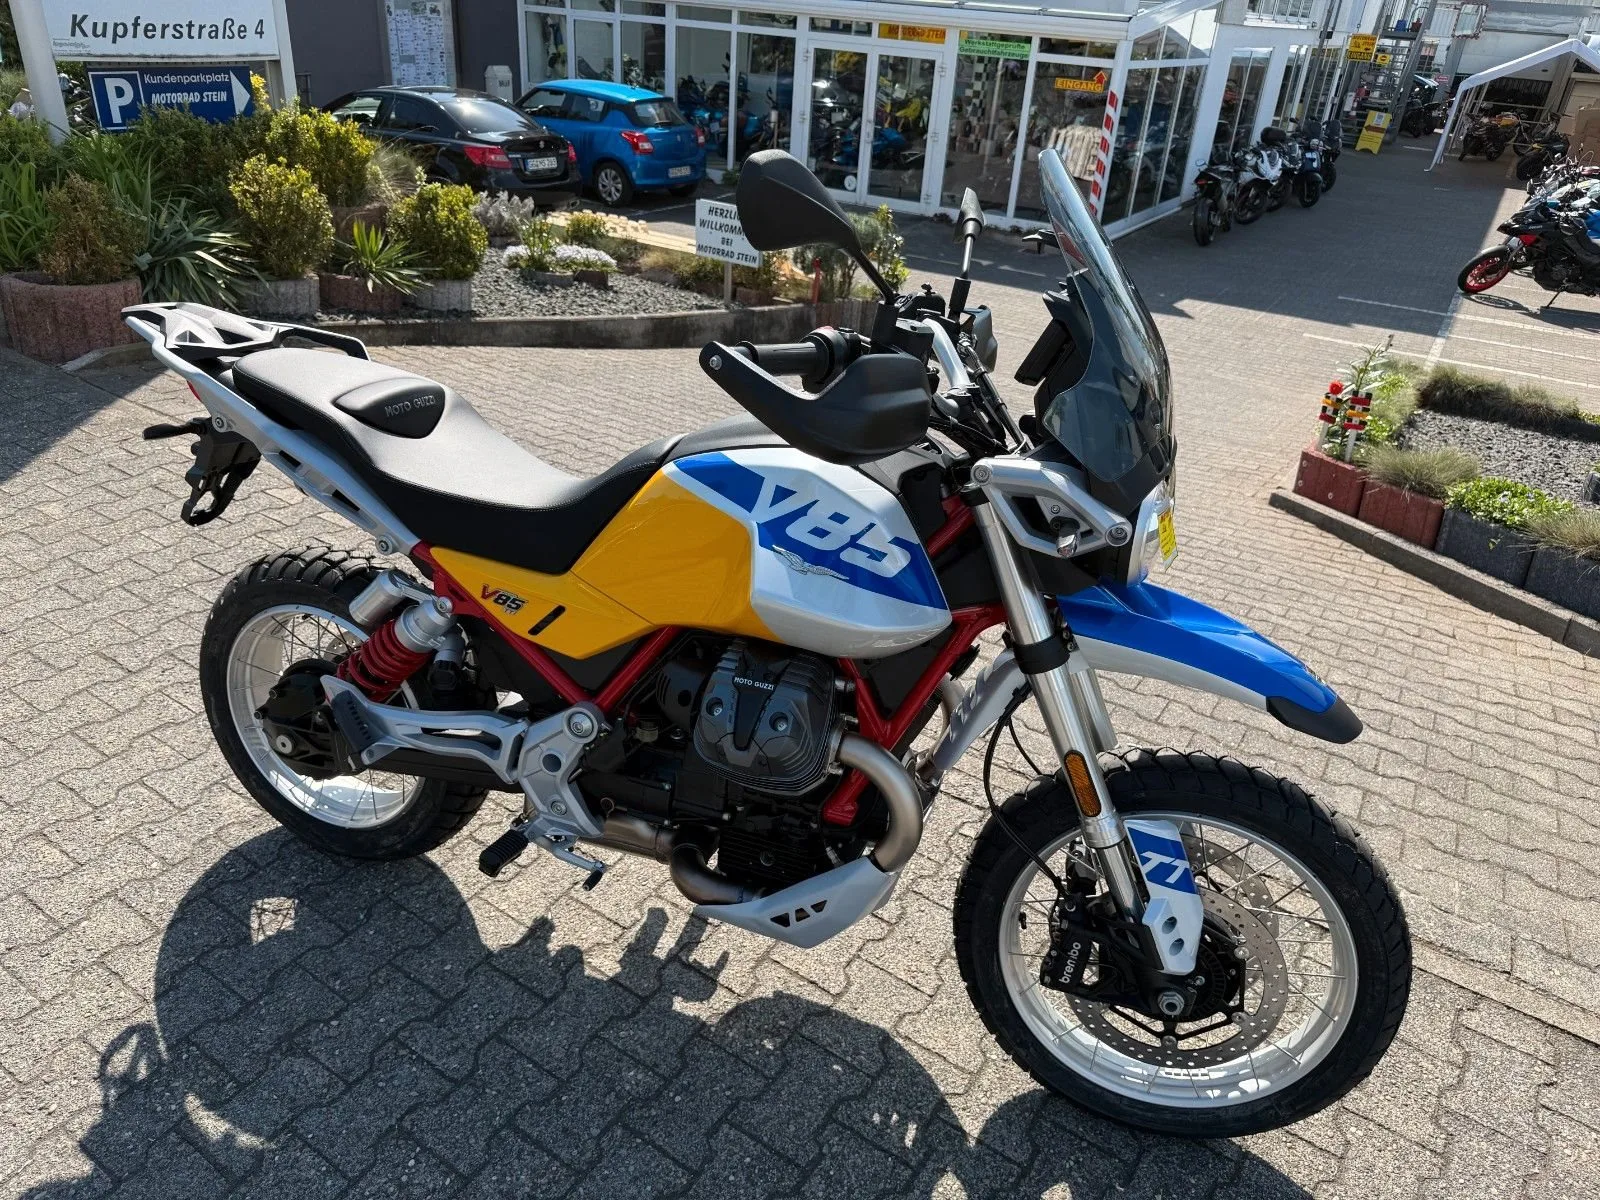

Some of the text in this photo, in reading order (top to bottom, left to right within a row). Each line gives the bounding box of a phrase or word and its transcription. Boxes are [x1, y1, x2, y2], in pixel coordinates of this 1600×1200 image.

[70, 14, 265, 44] Kupferstraße 4
[144, 70, 229, 84] Kundenparkplatz
[1056, 79, 1103, 91] EINGANG
[104, 77, 134, 124] P
[151, 91, 227, 104] MOTORRAD STEIN
[721, 237, 733, 247] BEI
[697, 244, 757, 264] MOTORRAD STEIN
[385, 395, 436, 416] MOTO GUZZI
[750, 476, 911, 578] V85
[481, 583, 526, 611] V85
[734, 676, 774, 690] MOTO GUZZI
[1141, 851, 1189, 884] TT
[1058, 941, 1082, 984] brembo
